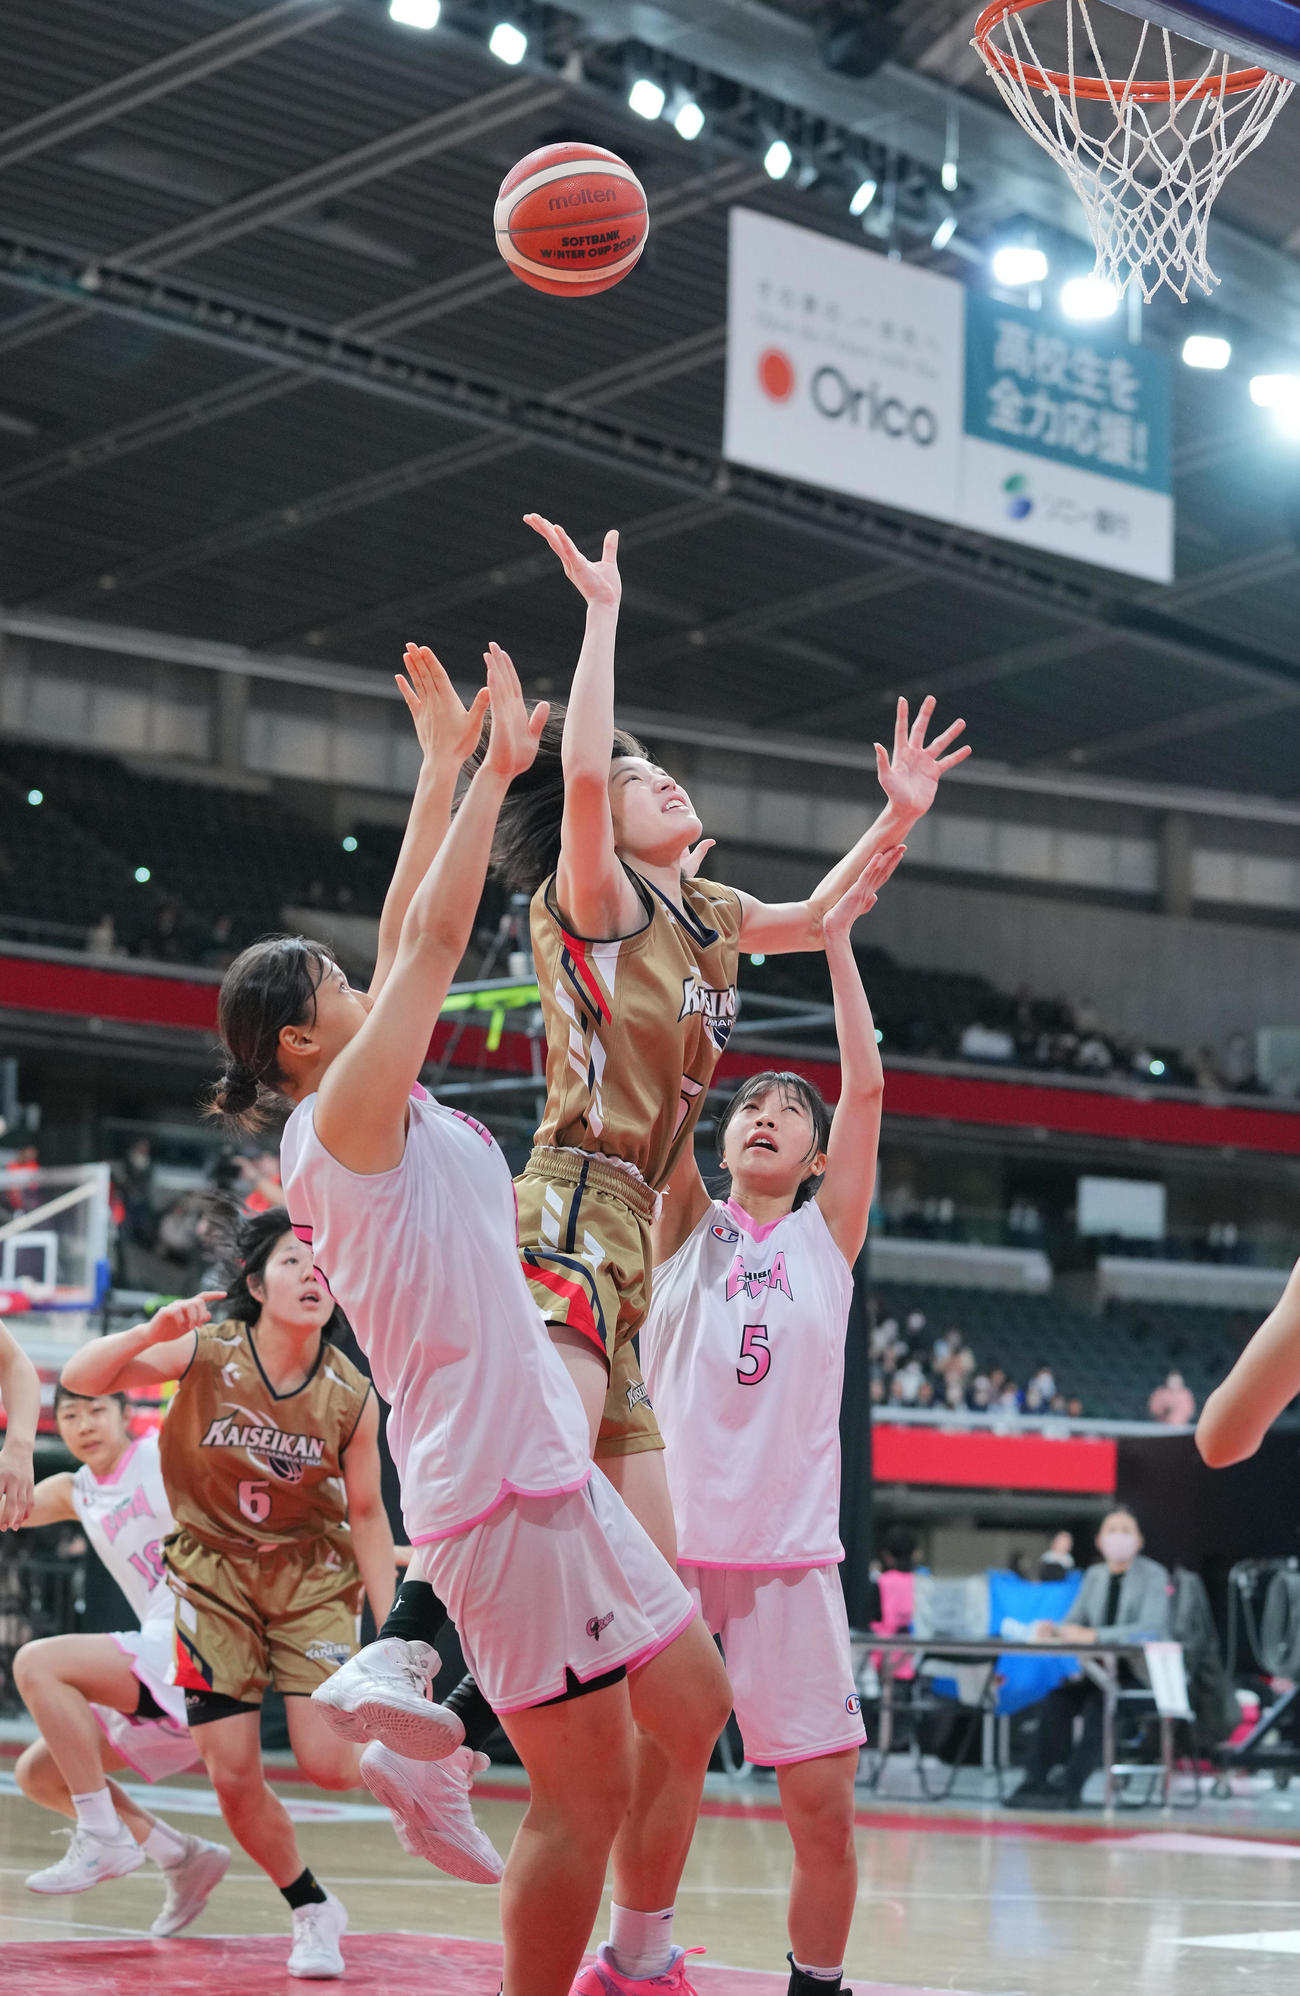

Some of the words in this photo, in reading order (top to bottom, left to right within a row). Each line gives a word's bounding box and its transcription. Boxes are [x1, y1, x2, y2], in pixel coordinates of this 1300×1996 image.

[548, 188, 617, 211] molten
[540, 247, 585, 259] WINTER
[588, 245, 611, 257] CUP
[613, 235, 637, 252] 2024
[561, 230, 620, 247] SOFTBANK
[811, 365, 938, 447] Orico
[736, 1324, 771, 1386] 5
[199, 1408, 327, 1459] KAISEIKAN
[238, 1479, 272, 1524] 6
